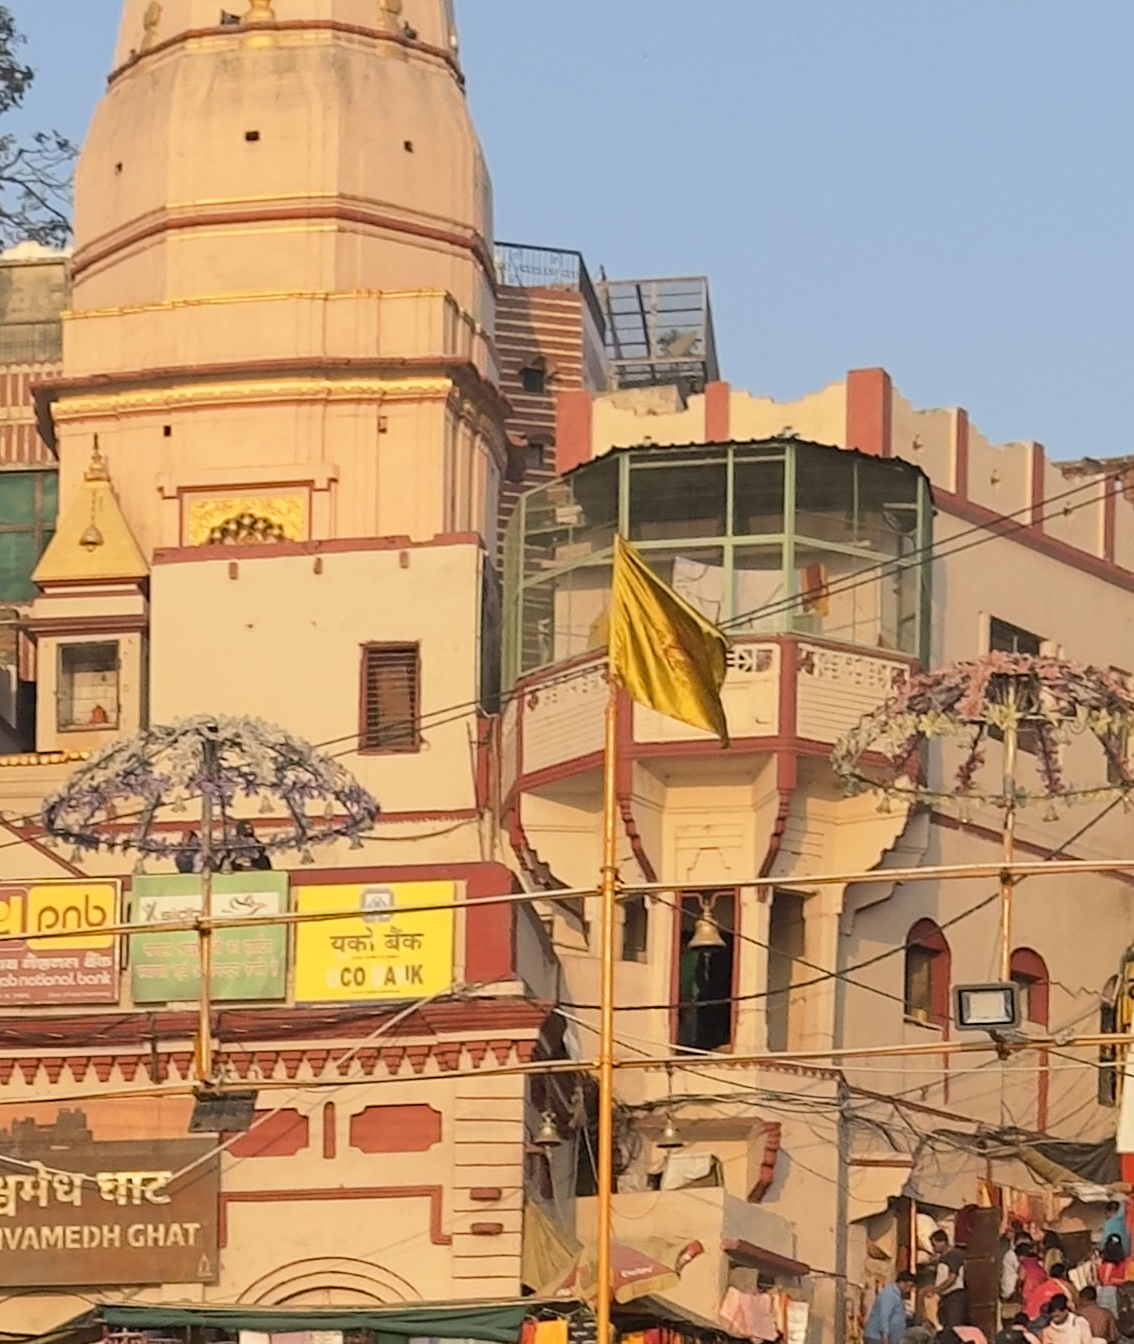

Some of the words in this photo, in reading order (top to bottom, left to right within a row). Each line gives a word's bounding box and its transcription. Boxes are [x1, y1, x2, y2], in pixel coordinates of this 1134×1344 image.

[37, 893, 107, 938] pnb
[383, 925, 424, 951] बैंक
[18, 972, 76, 987] national
[76, 970, 113, 985] bank
[96, 1171, 173, 1206] घाट
[127, 1222, 201, 1248] GHAT
